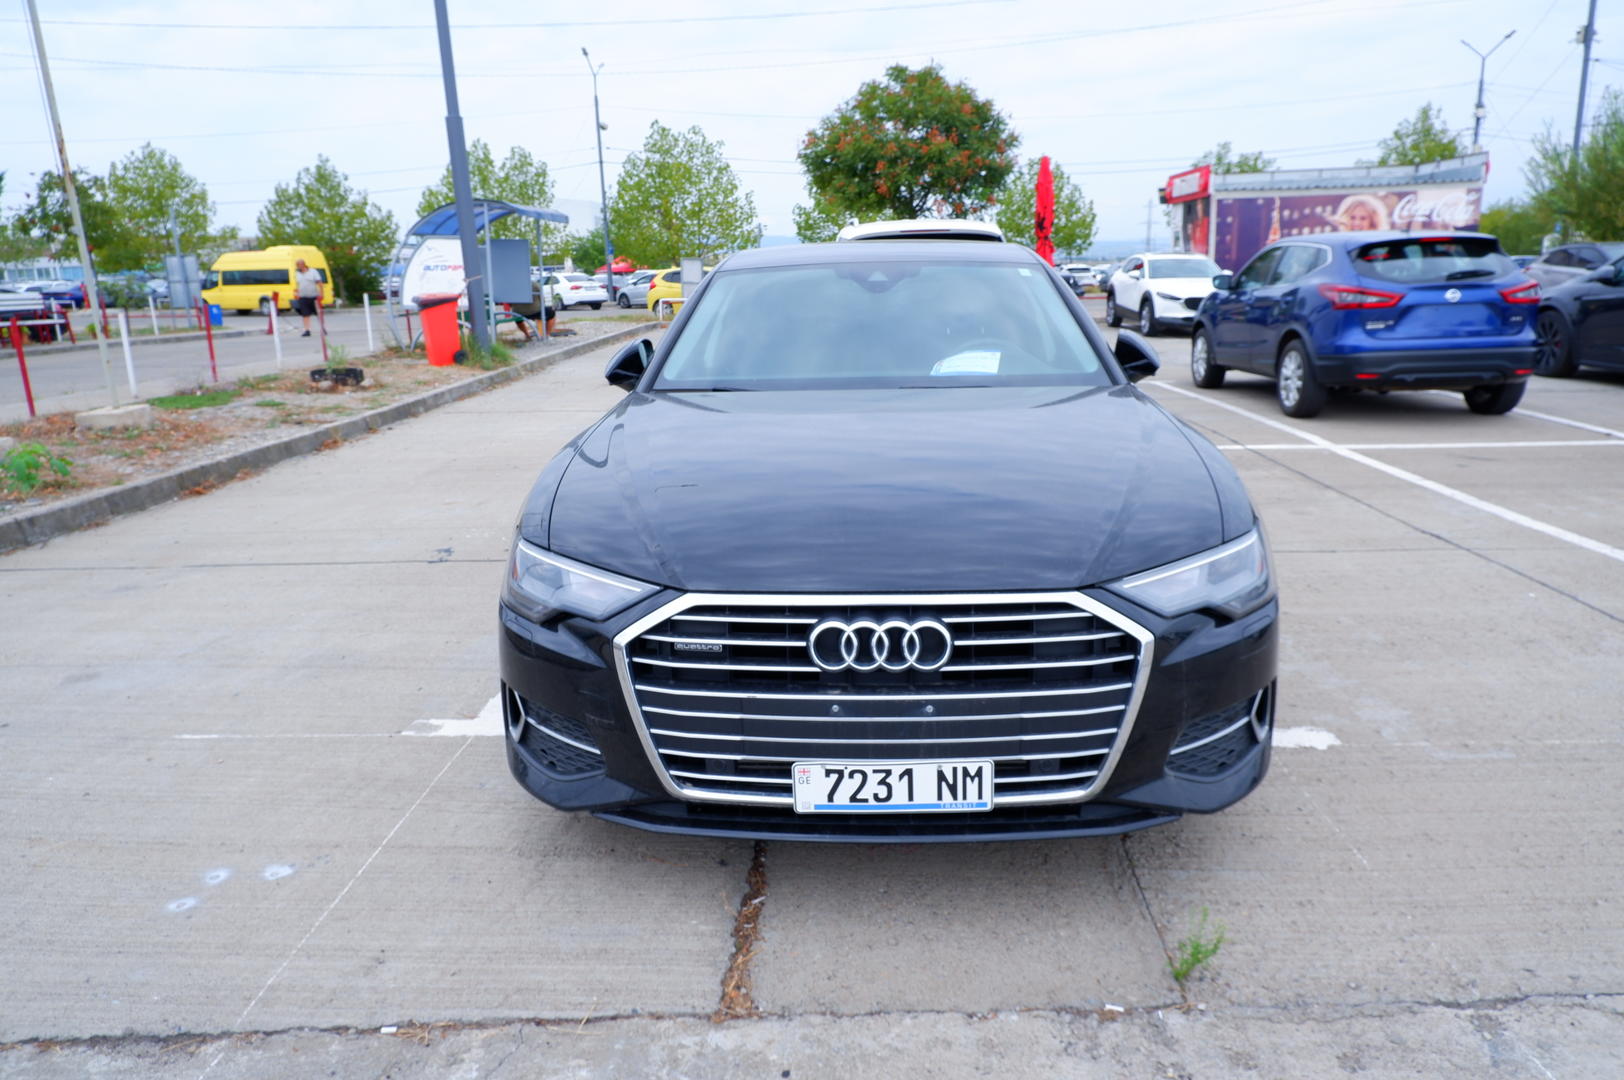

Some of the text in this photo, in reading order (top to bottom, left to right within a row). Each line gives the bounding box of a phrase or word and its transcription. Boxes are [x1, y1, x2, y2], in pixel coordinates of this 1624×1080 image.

[798, 776, 812, 785] GE
[824, 766, 983, 804] 7231 NM
